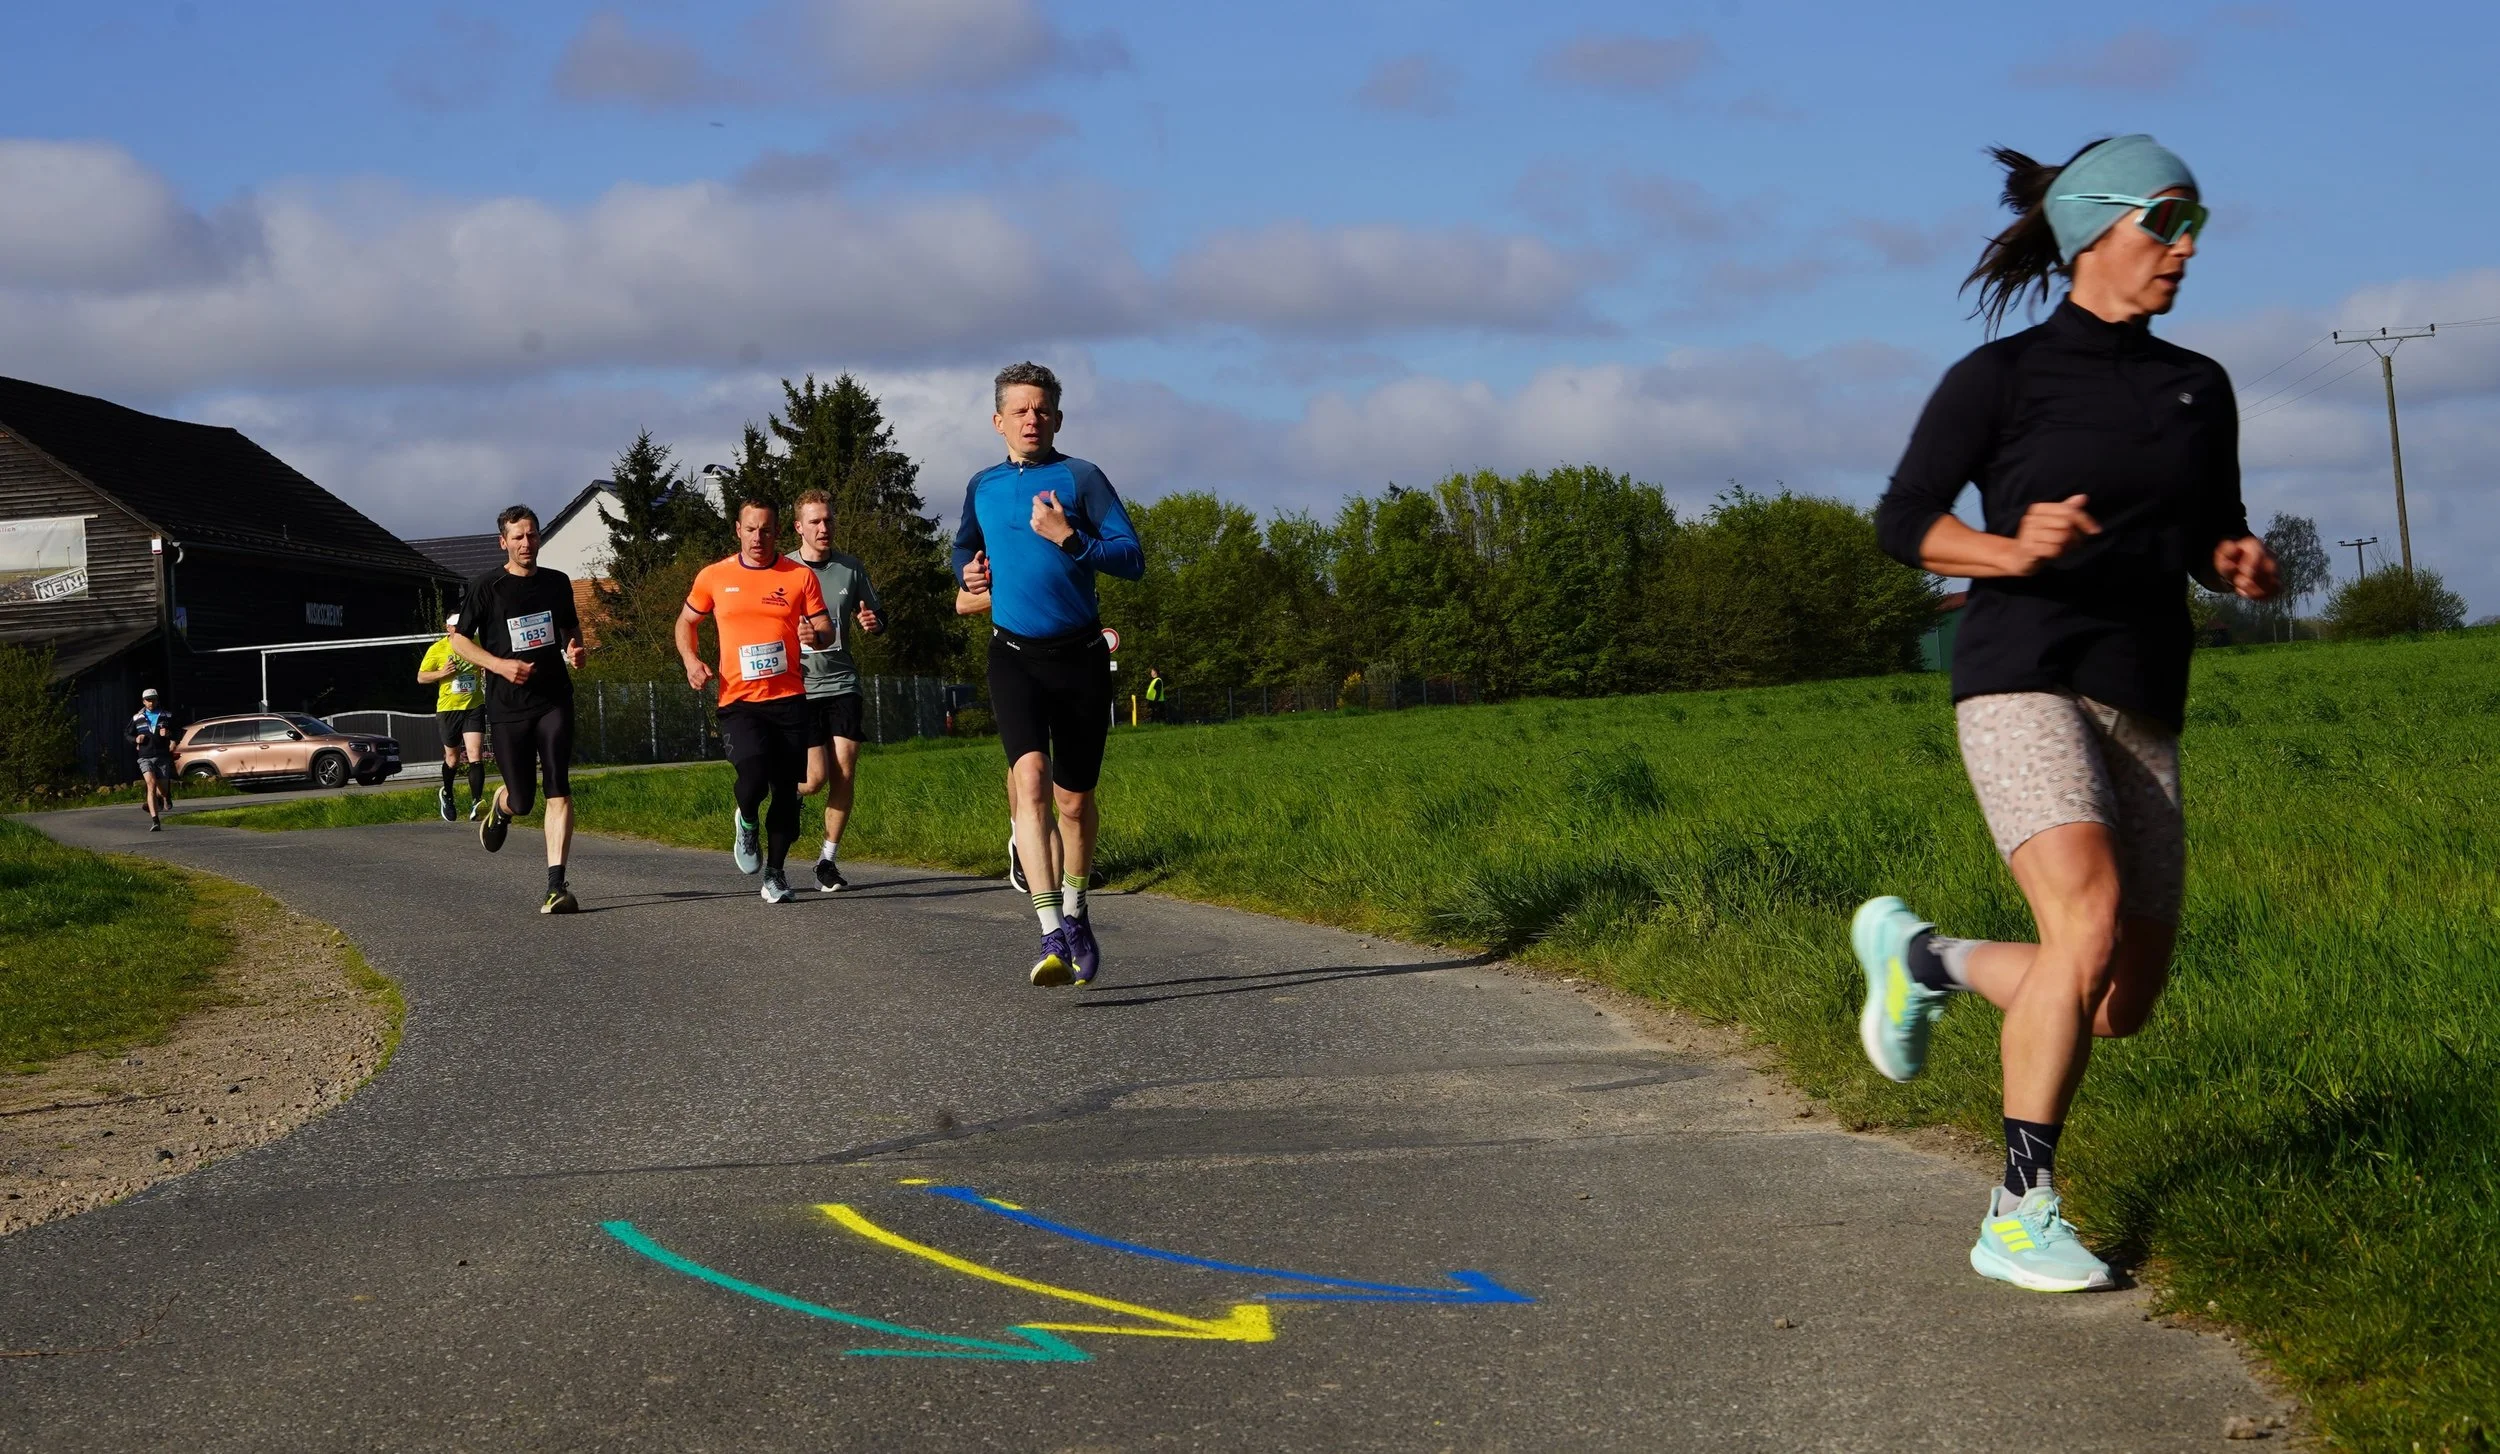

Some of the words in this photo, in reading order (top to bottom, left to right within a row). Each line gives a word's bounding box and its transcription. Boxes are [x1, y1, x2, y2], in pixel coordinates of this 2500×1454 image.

[39, 574, 86, 599] NEIN!
[520, 628, 546, 641] 1635
[750, 657, 779, 670] 1629
